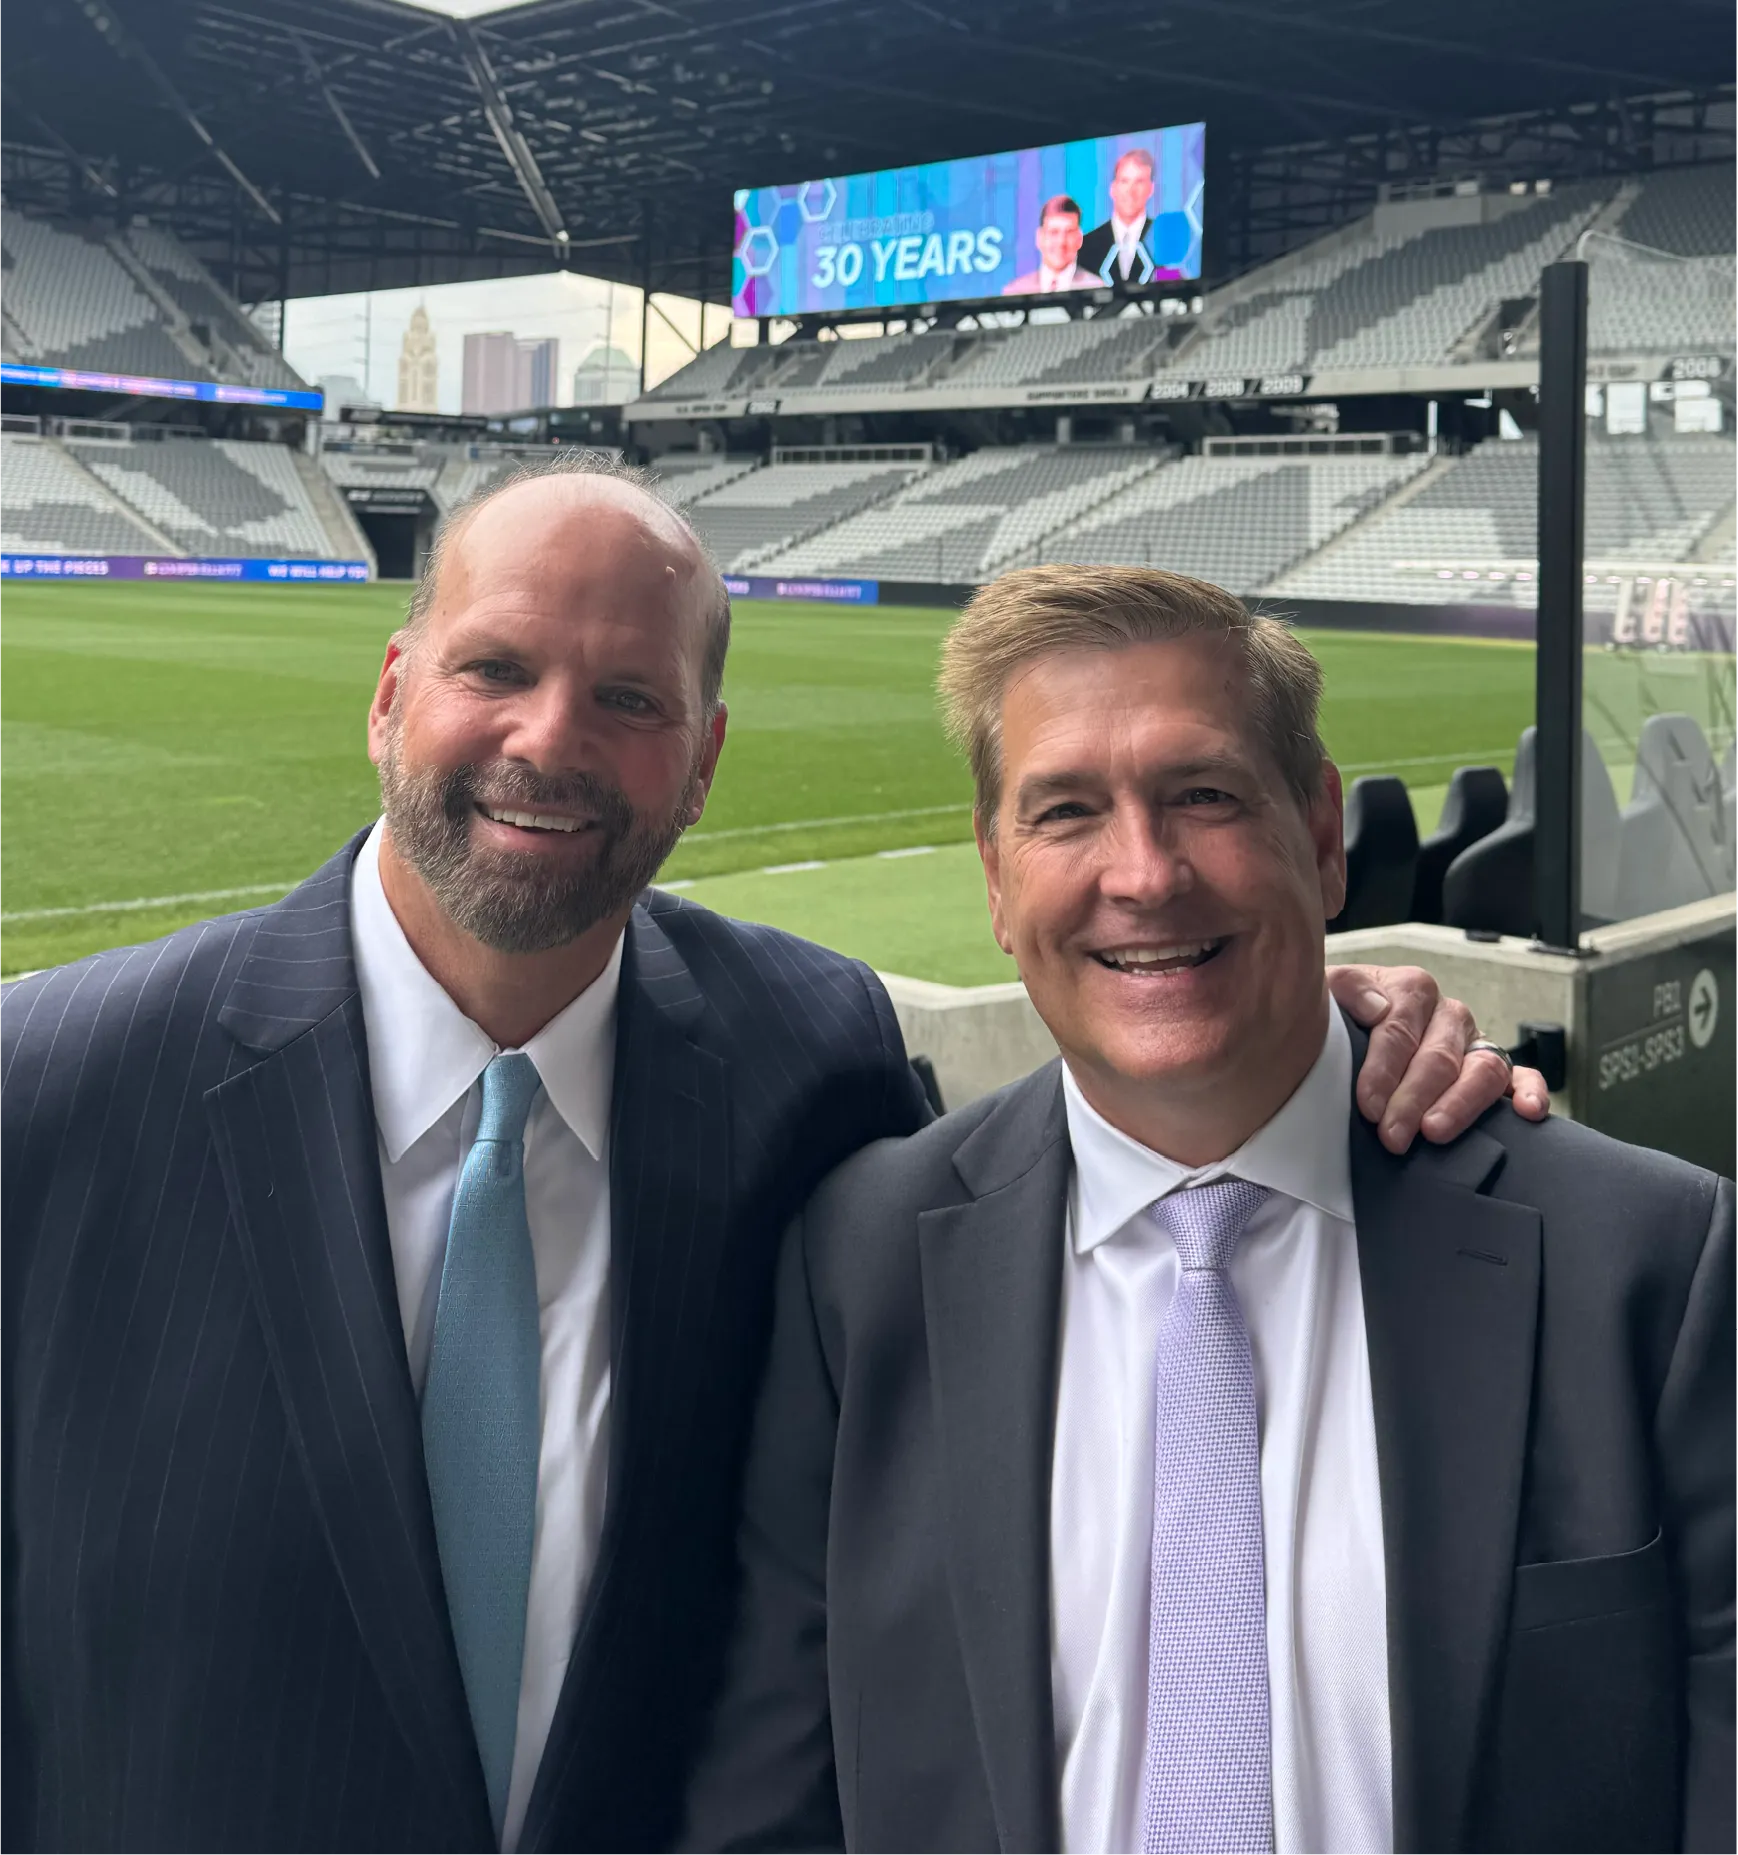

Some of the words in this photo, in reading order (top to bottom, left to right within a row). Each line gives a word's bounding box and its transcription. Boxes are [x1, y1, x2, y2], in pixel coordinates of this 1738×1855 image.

[811, 243, 863, 288] 30
[871, 226, 1003, 282] YEARS
[14, 559, 34, 574] UP
[35, 560, 61, 574] THE
[63, 560, 109, 575] PIECES
[267, 564, 288, 577] WE
[318, 565, 346, 578] HELP
